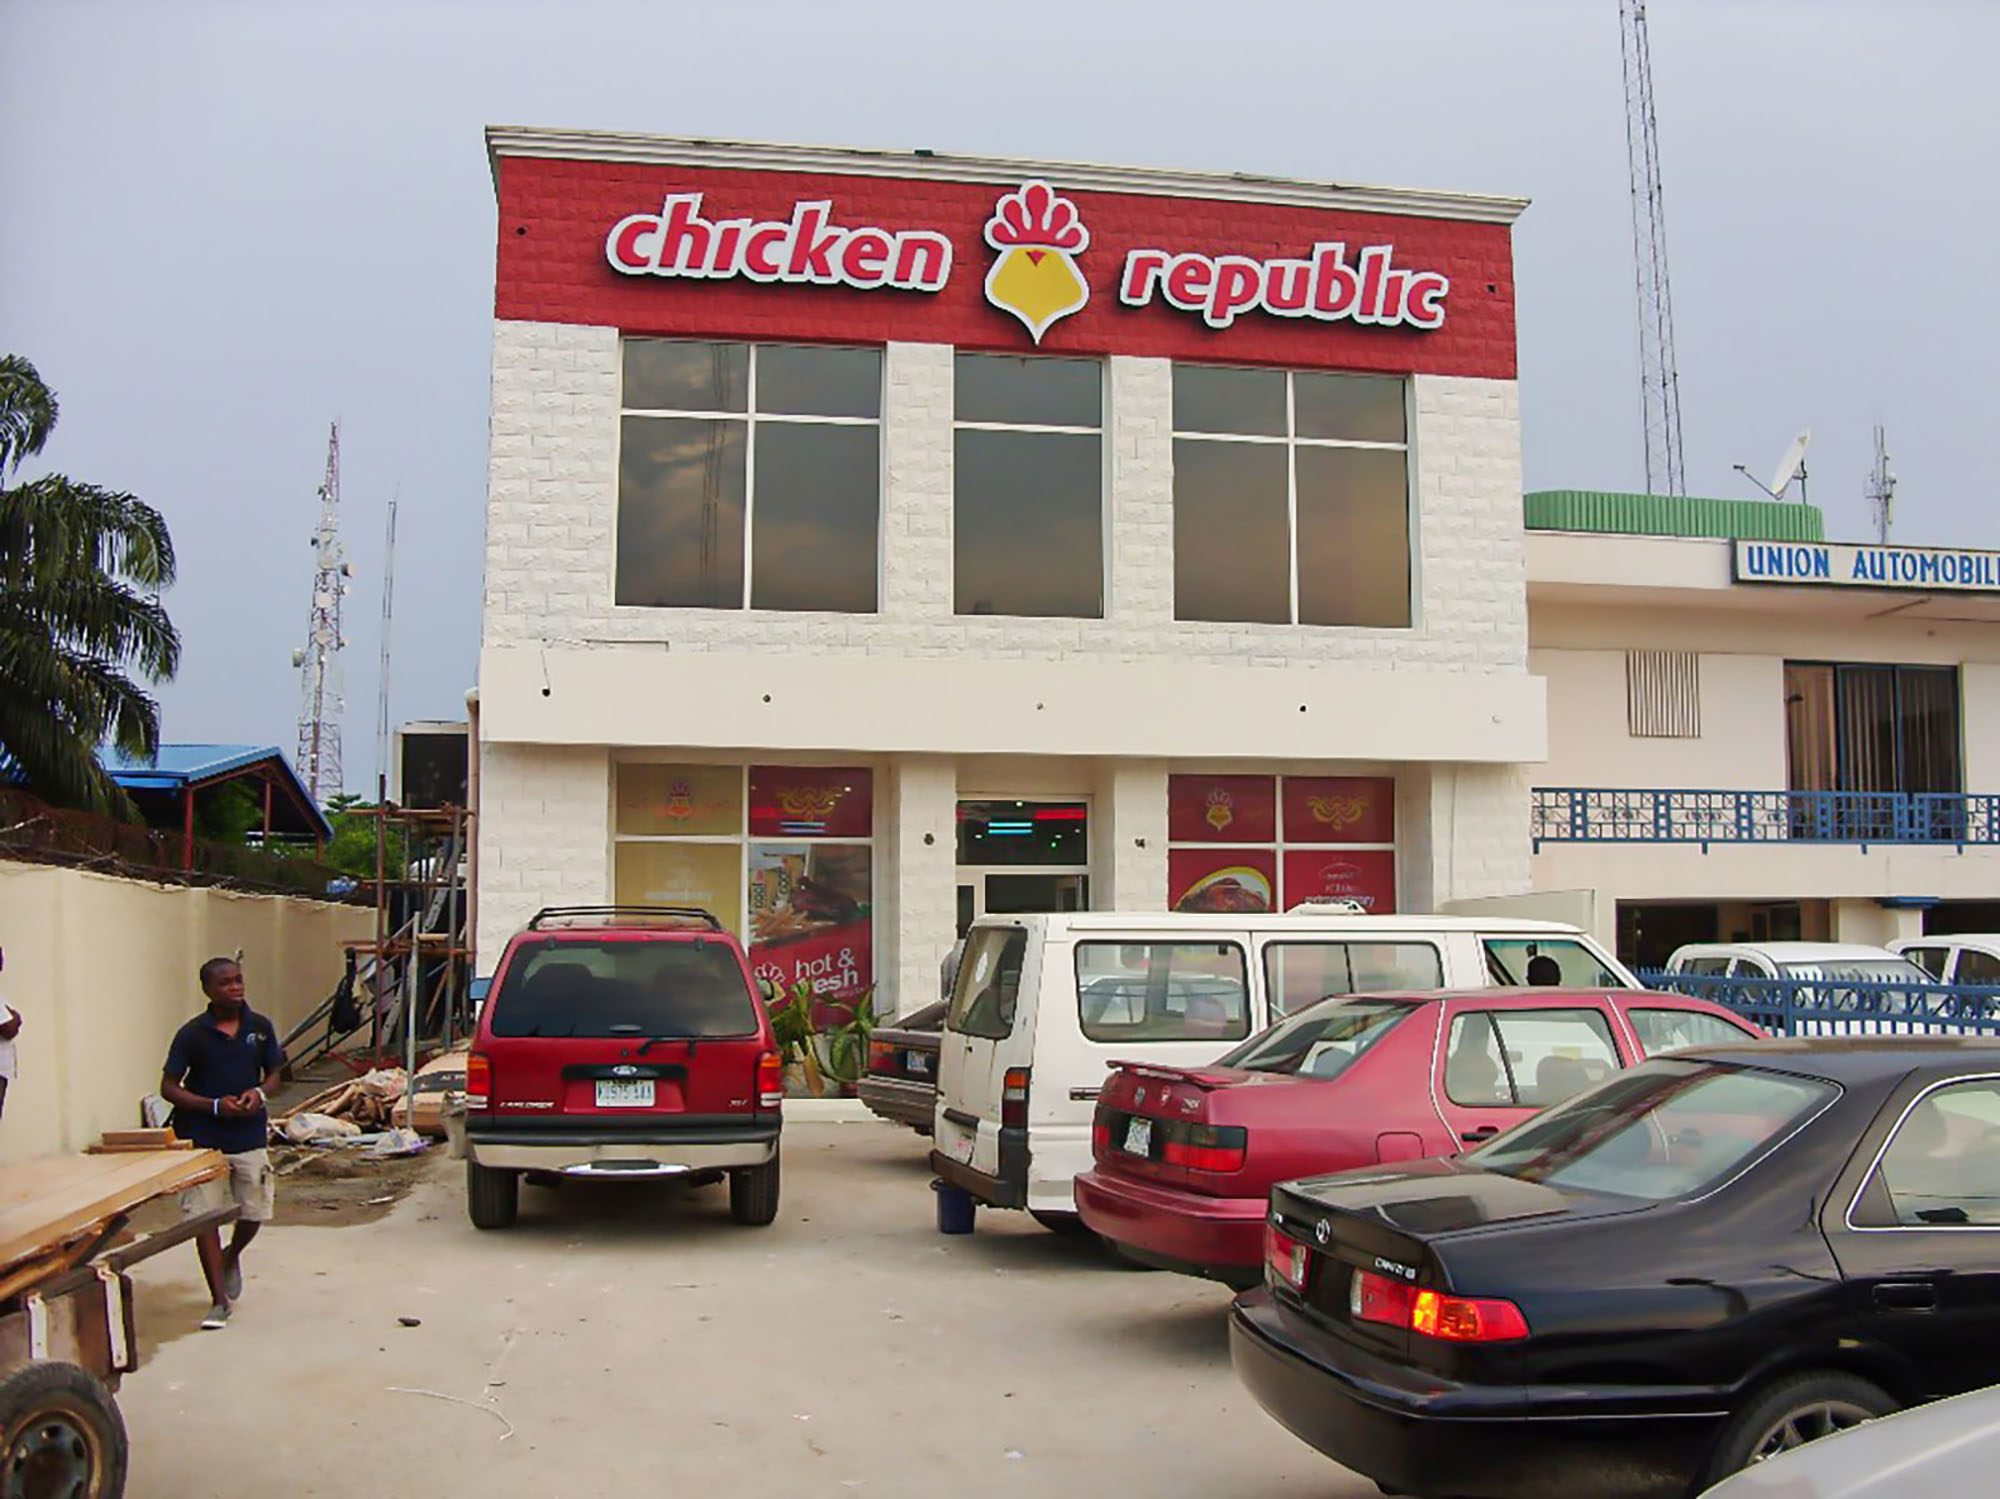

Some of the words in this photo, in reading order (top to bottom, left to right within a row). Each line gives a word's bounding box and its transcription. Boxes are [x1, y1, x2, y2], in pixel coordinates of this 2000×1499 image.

[609, 195, 950, 289] chicken
[1123, 244, 1446, 326] republic
[1747, 545, 1830, 578] UNION
[1852, 549, 2000, 585] AUTOMOBIL
[795, 953, 832, 979] hot
[837, 947, 855, 968] &
[798, 967, 859, 994] esh
